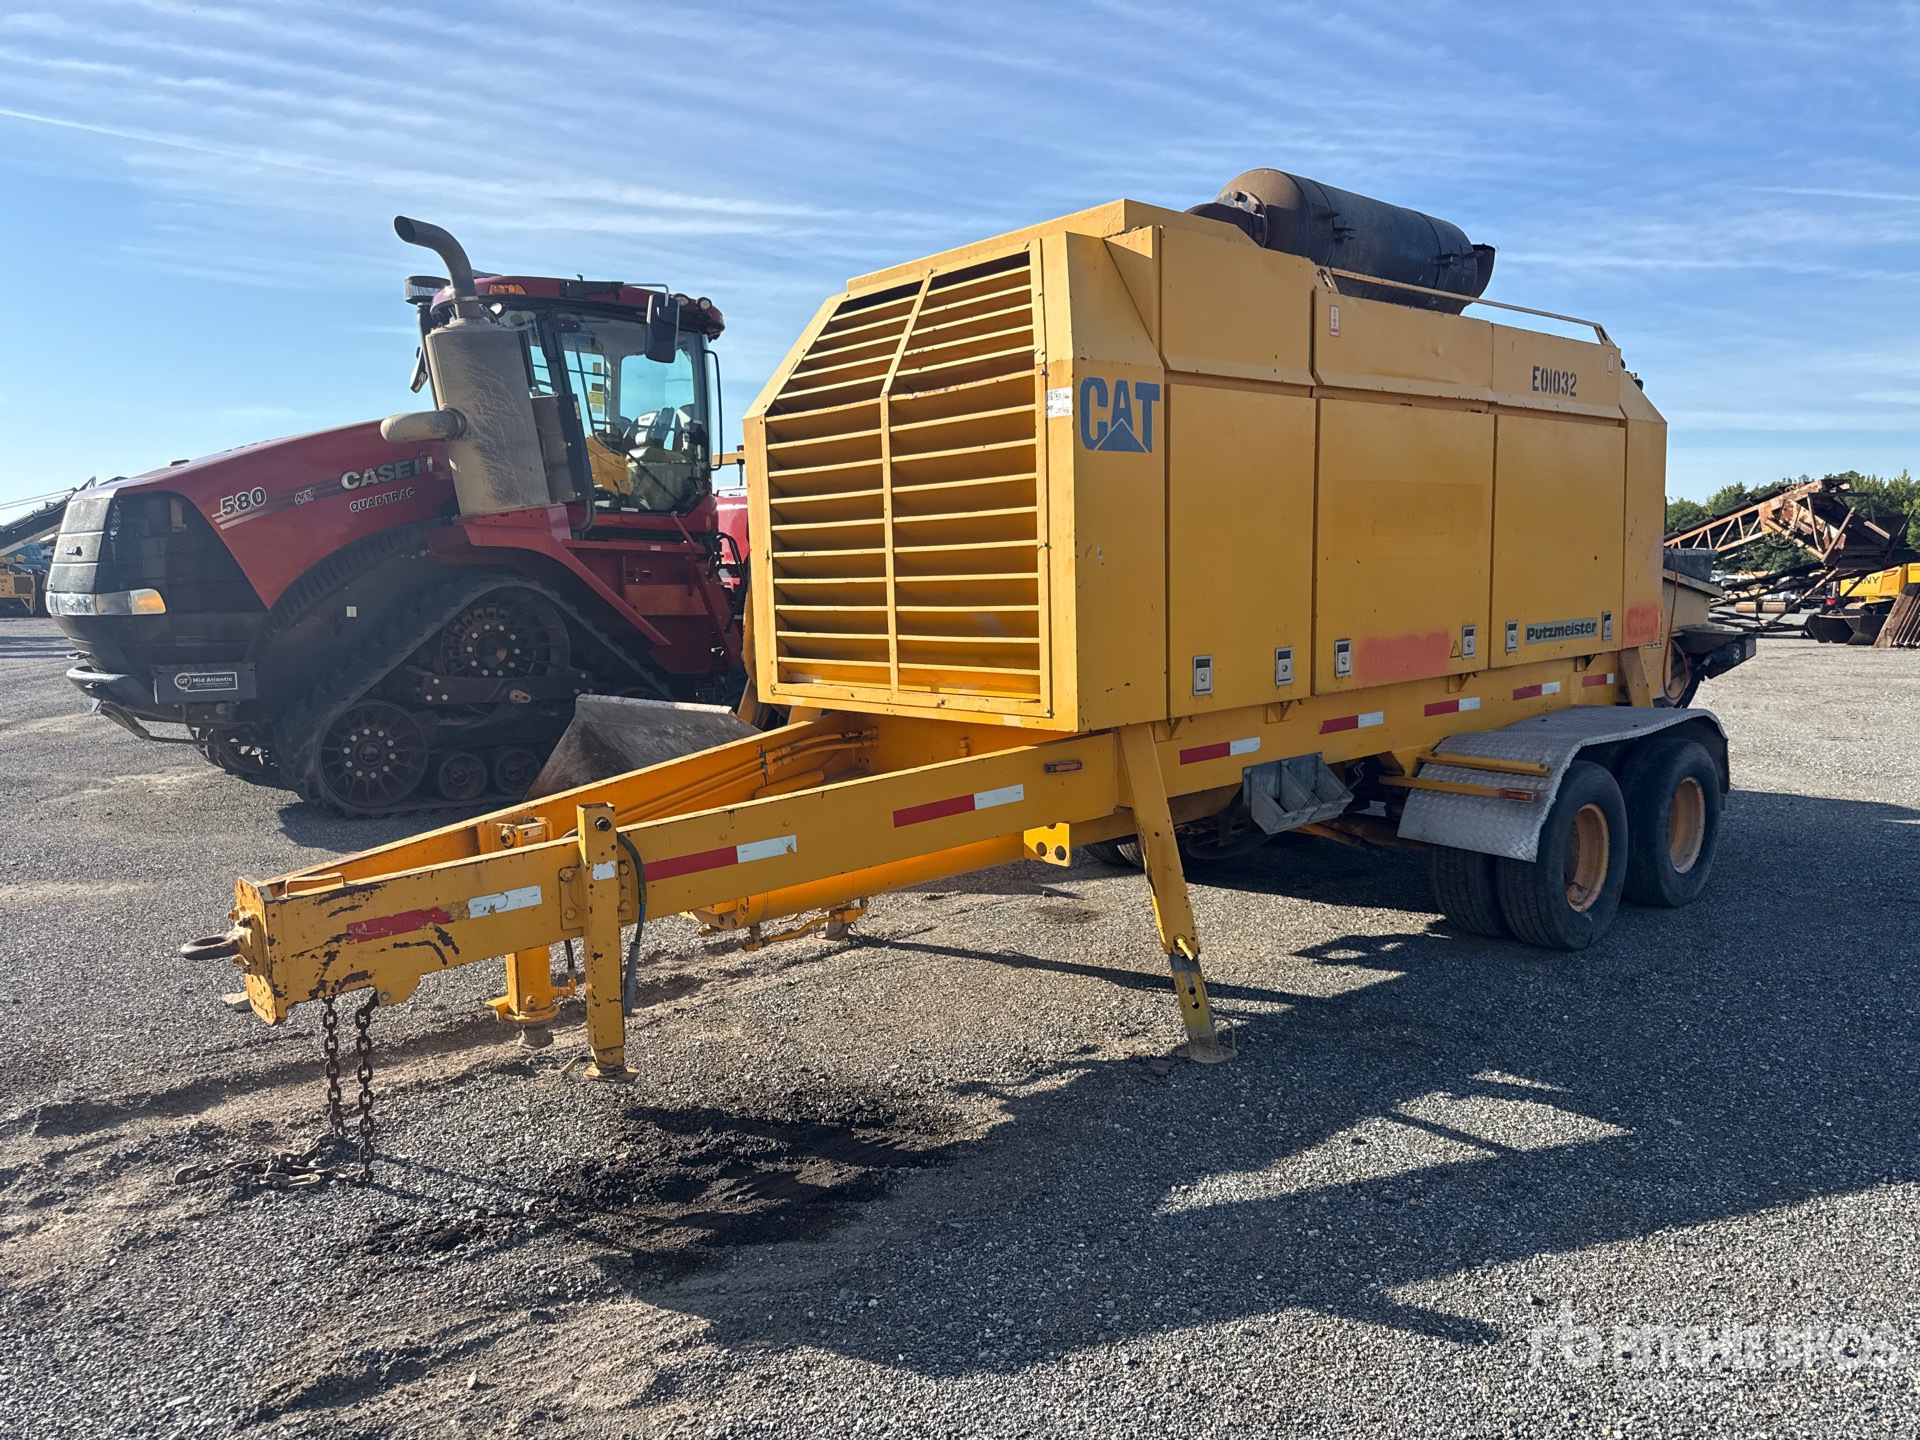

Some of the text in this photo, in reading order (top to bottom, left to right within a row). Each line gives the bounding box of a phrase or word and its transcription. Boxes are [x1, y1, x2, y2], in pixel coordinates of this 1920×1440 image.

[1532, 365, 1577, 397] E01032
[1080, 376, 1160, 453] CAT
[340, 459, 411, 490] CASE
[220, 487, 267, 516] 580
[350, 488, 415, 512] QUADTRAC
[1526, 621, 1597, 641] Putzmeister
